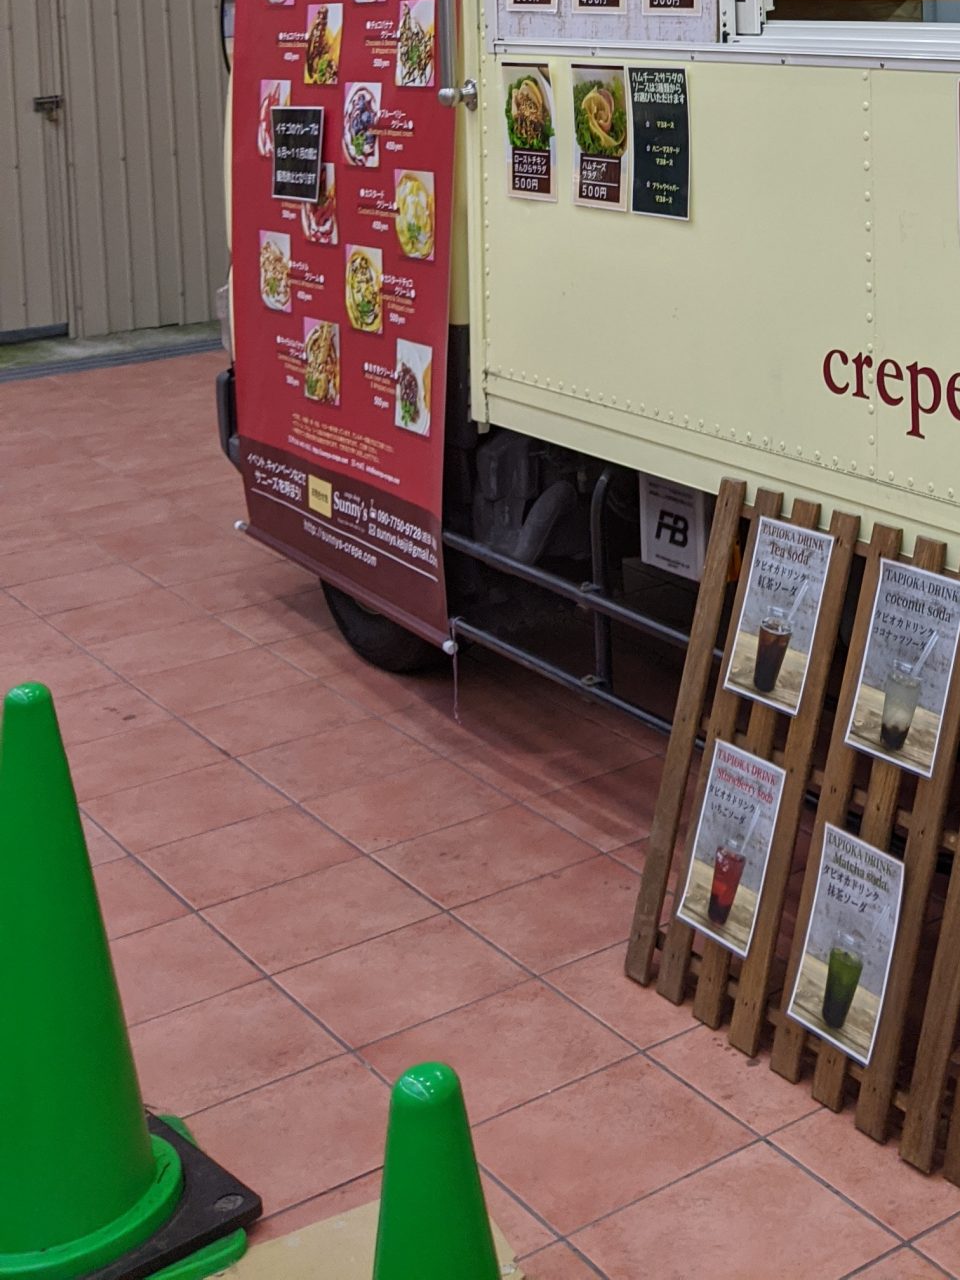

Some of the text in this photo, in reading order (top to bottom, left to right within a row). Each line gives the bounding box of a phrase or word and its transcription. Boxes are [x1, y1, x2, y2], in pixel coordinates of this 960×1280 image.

[514, 154, 546, 166] ローストチキン
[582, 161, 607, 172] ハムチーズ
[514, 177, 539, 191] 500円
[581, 185, 607, 200] 500円
[333, 491, 369, 522] Sunny's
[655, 508, 689, 549] FB
[762, 523, 825, 552] TAPIOKA DRINK
[770, 541, 809, 566] Tea soda
[755, 558, 808, 584] タピオカドリンク
[757, 574, 799, 597] 紅茶ソーダ
[885, 568, 959, 604] TAPIOKA DRINK
[884, 591, 952, 624] coconut soda
[875, 609, 936, 638] タピオカドリンク
[717, 748, 778, 786] TAPIOKA DRINK
[709, 783, 757, 813] タピオカドリンク
[710, 800, 747, 825] いちごソーダ
[827, 831, 893, 876] TAPIOKA DRINK
[832, 852, 866, 878] Matcha
[823, 863, 880, 902] タピオカドリンク
[827, 882, 869, 914] 抹茶ソーダ
